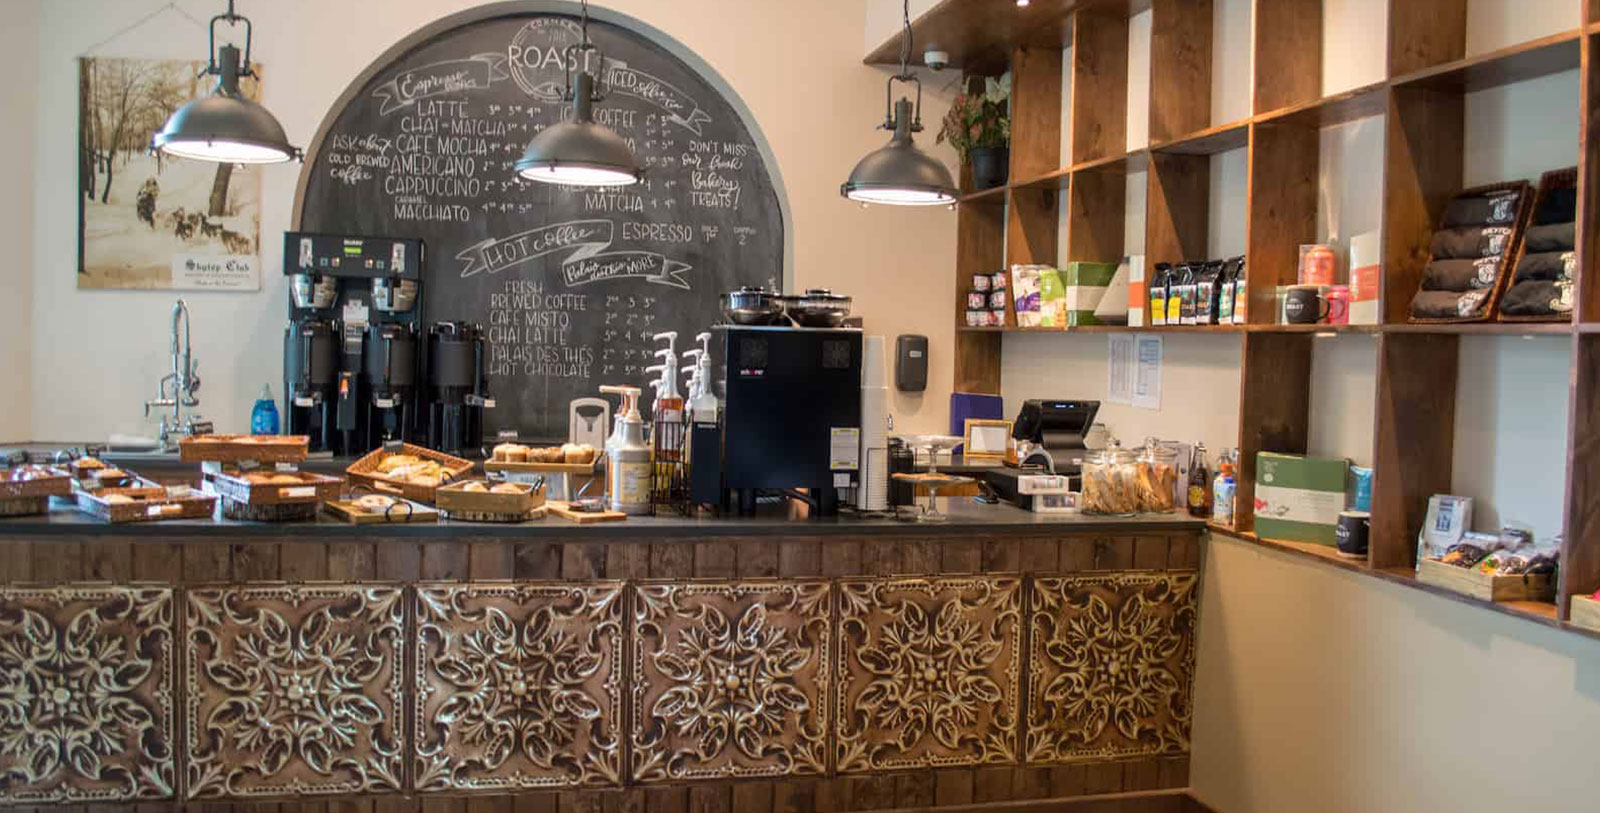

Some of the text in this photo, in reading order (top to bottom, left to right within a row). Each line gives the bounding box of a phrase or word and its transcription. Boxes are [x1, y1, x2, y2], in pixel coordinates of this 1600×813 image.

[508, 45, 597, 71] ROAST
[610, 70, 637, 88] ICED
[332, 134, 359, 152] ASK
[437, 137, 487, 156] MOCHA
[688, 140, 719, 154] DON'T
[723, 141, 748, 157] MISS
[328, 152, 391, 168] COLD BREWED
[390, 154, 475, 178] AMERICANO
[385, 175, 480, 198] CAPPUCCINO
[394, 203, 470, 221] MACCHIATO
[585, 192, 644, 214] MATCHA
[622, 221, 693, 242] ESPRESSO
[484, 236, 528, 269] HOT
[504, 280, 543, 294] FRESH
[490, 293, 542, 310] BREWED
[545, 294, 587, 310] COFFEE
[525, 310, 570, 328] MISTO
[488, 326, 521, 344] CHAI
[525, 327, 567, 345] LATTE
[491, 345, 533, 362] PALAIS
[536, 346, 560, 362] DES
[488, 361, 518, 376] HOT
[524, 362, 591, 378] CHOCOLATE
